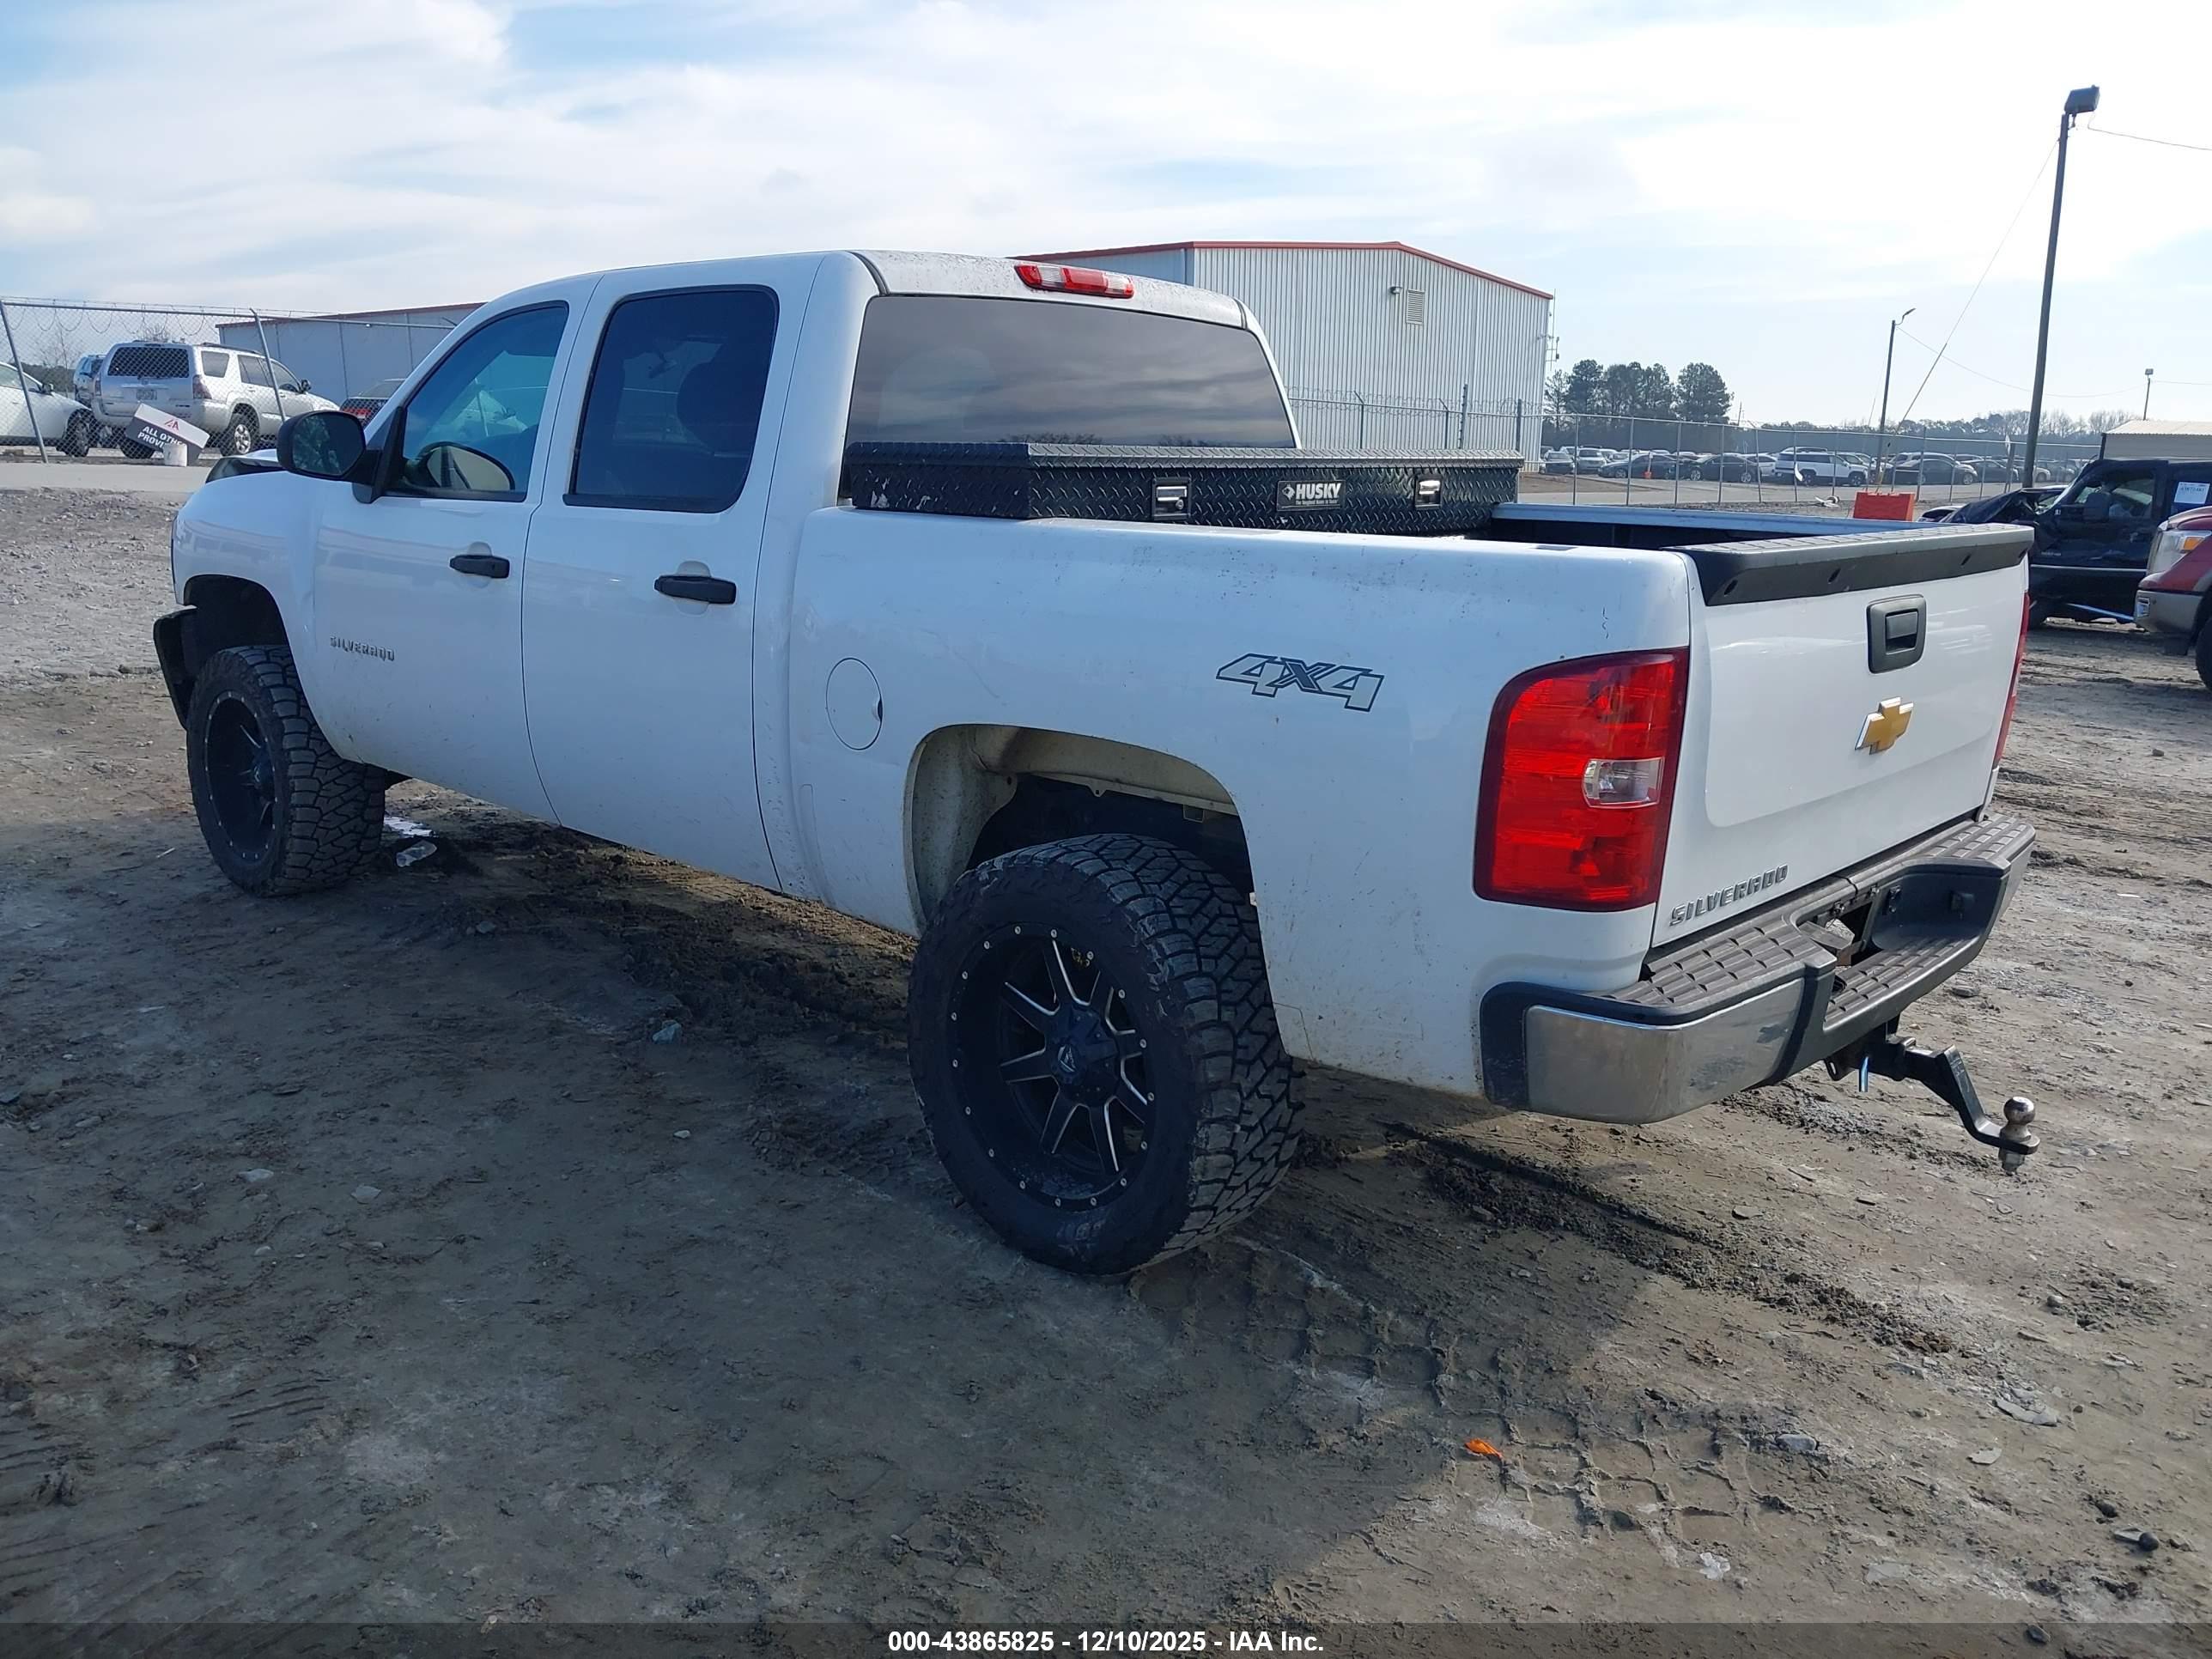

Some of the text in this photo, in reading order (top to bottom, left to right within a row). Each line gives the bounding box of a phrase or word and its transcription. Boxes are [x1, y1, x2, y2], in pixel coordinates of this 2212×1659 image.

[137, 432, 166, 448] PROVI
[143, 426, 158, 438] ALL
[1296, 483, 1341, 500] HUSKY
[330, 635, 395, 661] SILVERADO
[1669, 864, 1788, 927] SILVERADO
